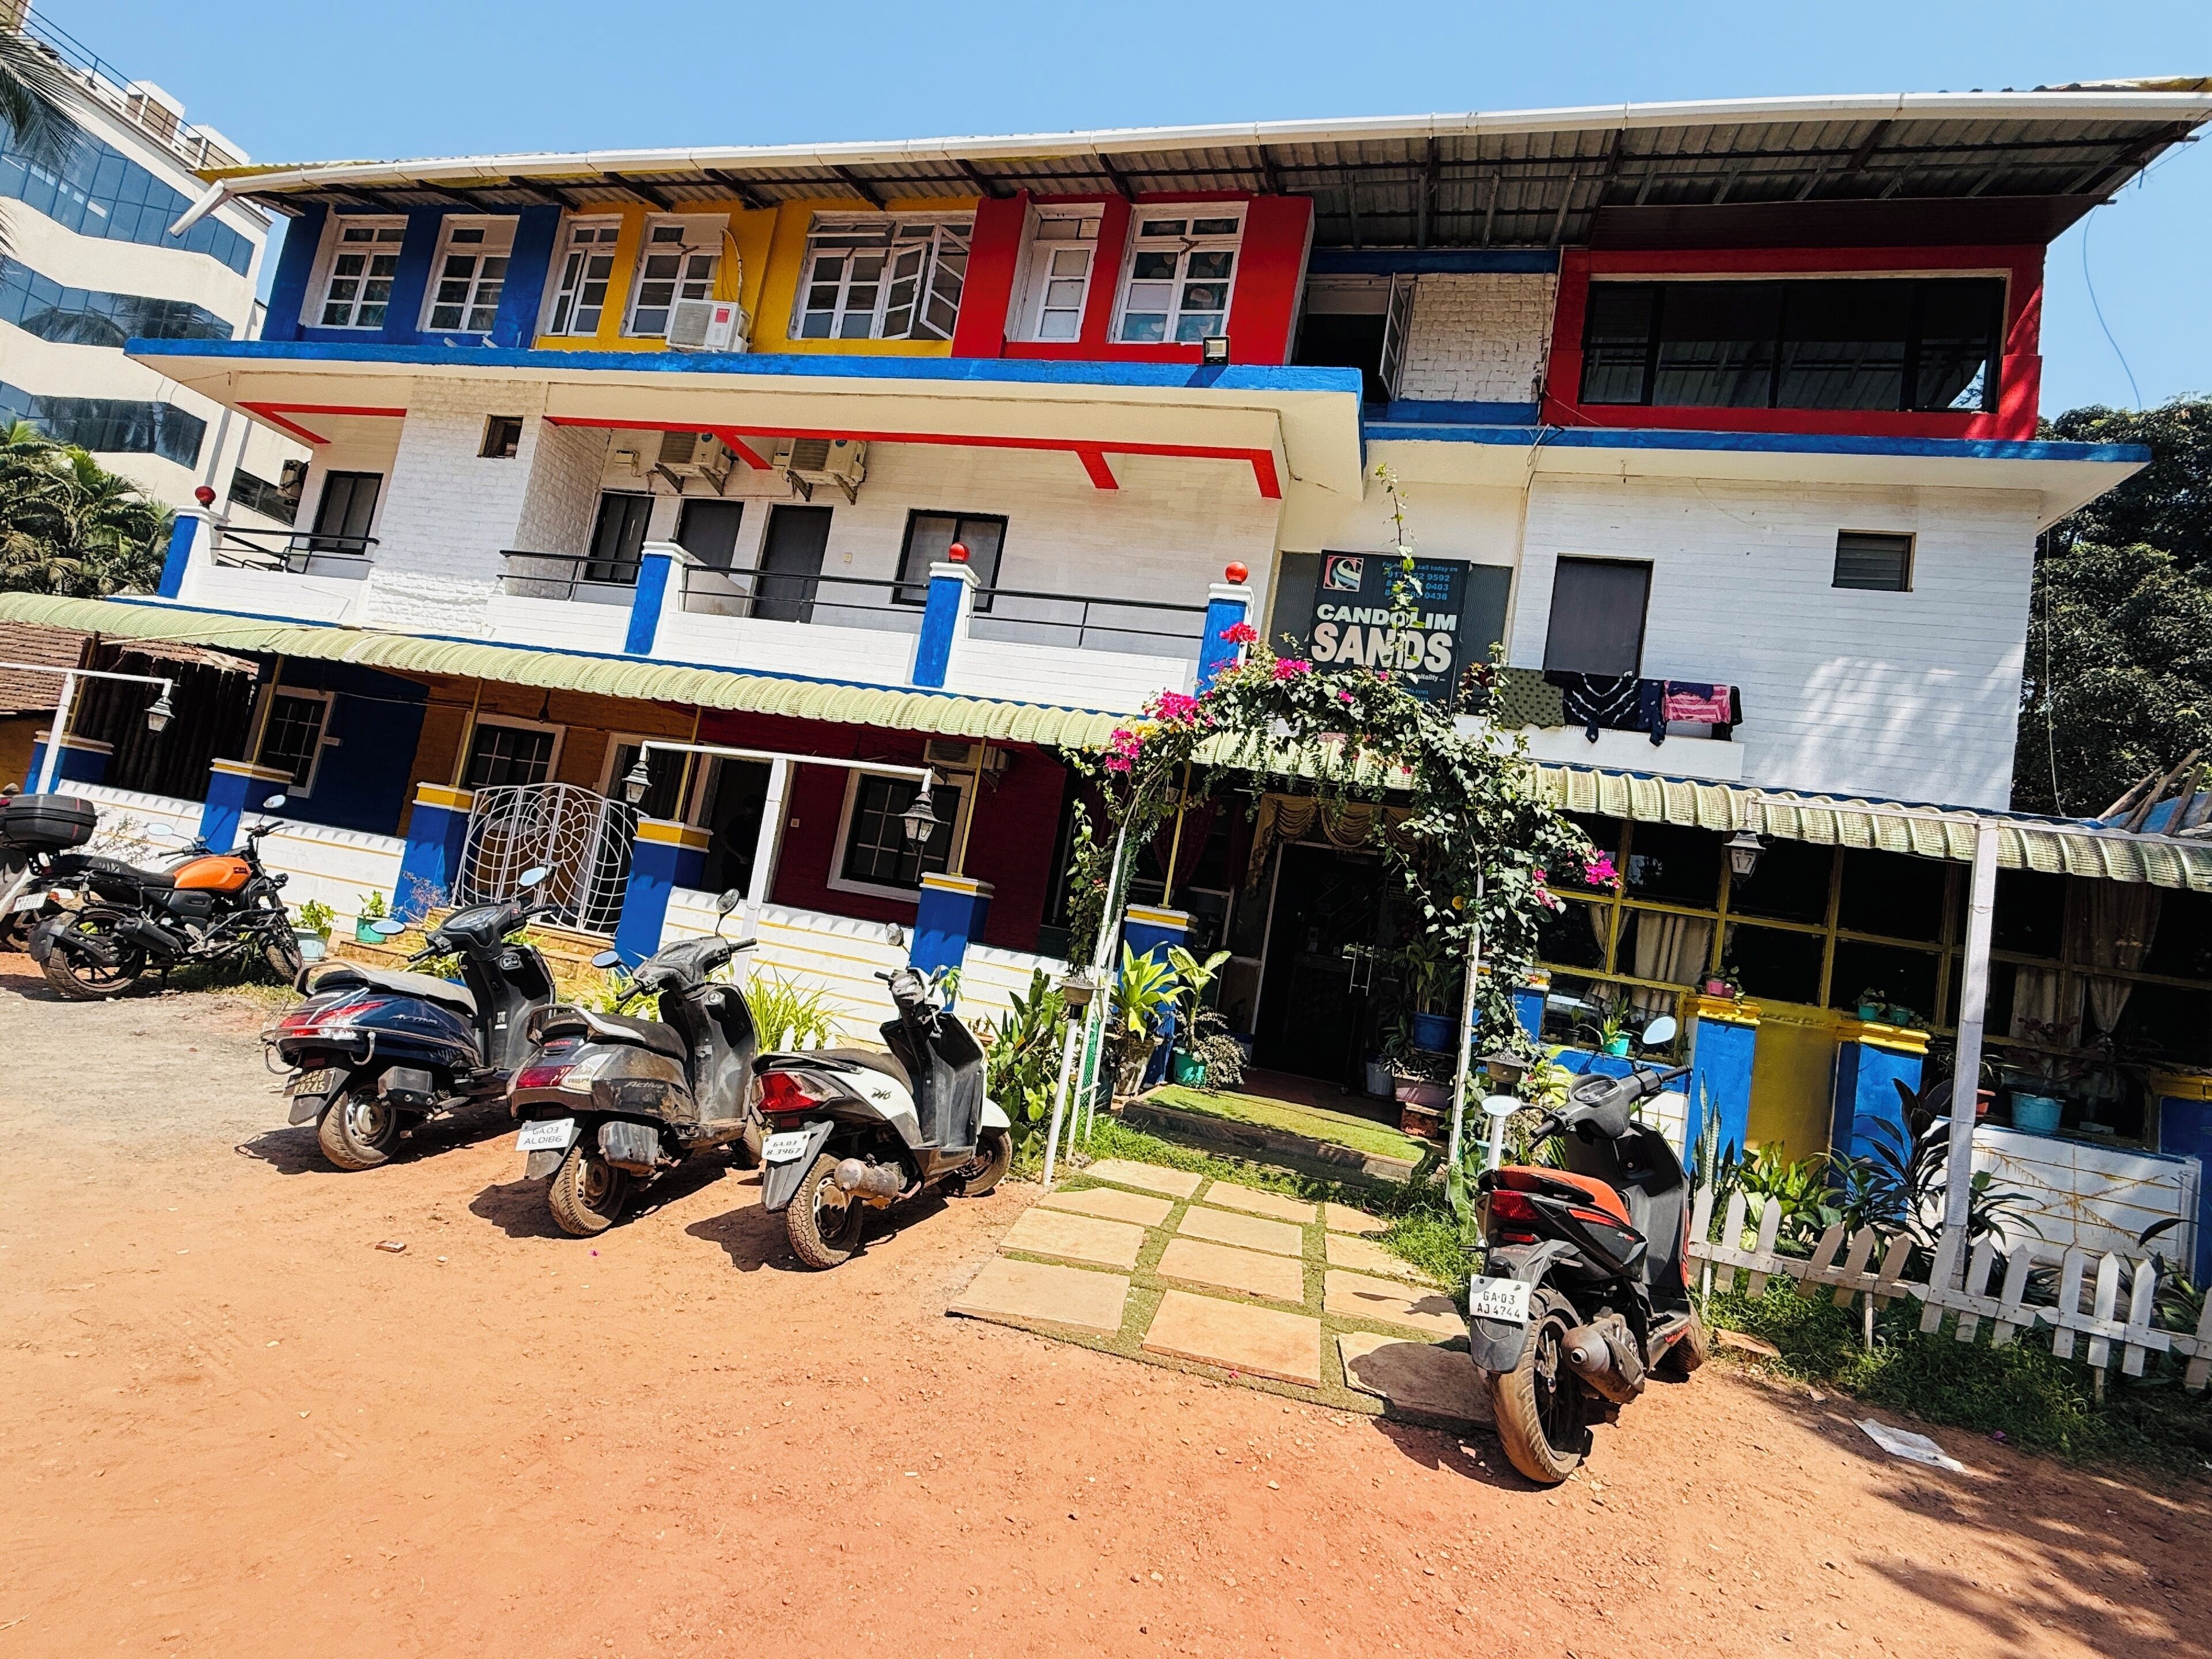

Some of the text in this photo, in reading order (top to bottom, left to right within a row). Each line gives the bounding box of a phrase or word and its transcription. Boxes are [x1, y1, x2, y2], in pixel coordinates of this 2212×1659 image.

[1317, 604, 1457, 631] CANDOLIM
[1311, 622, 1453, 673] SANDS
[624, 1081, 665, 1089] Activa
